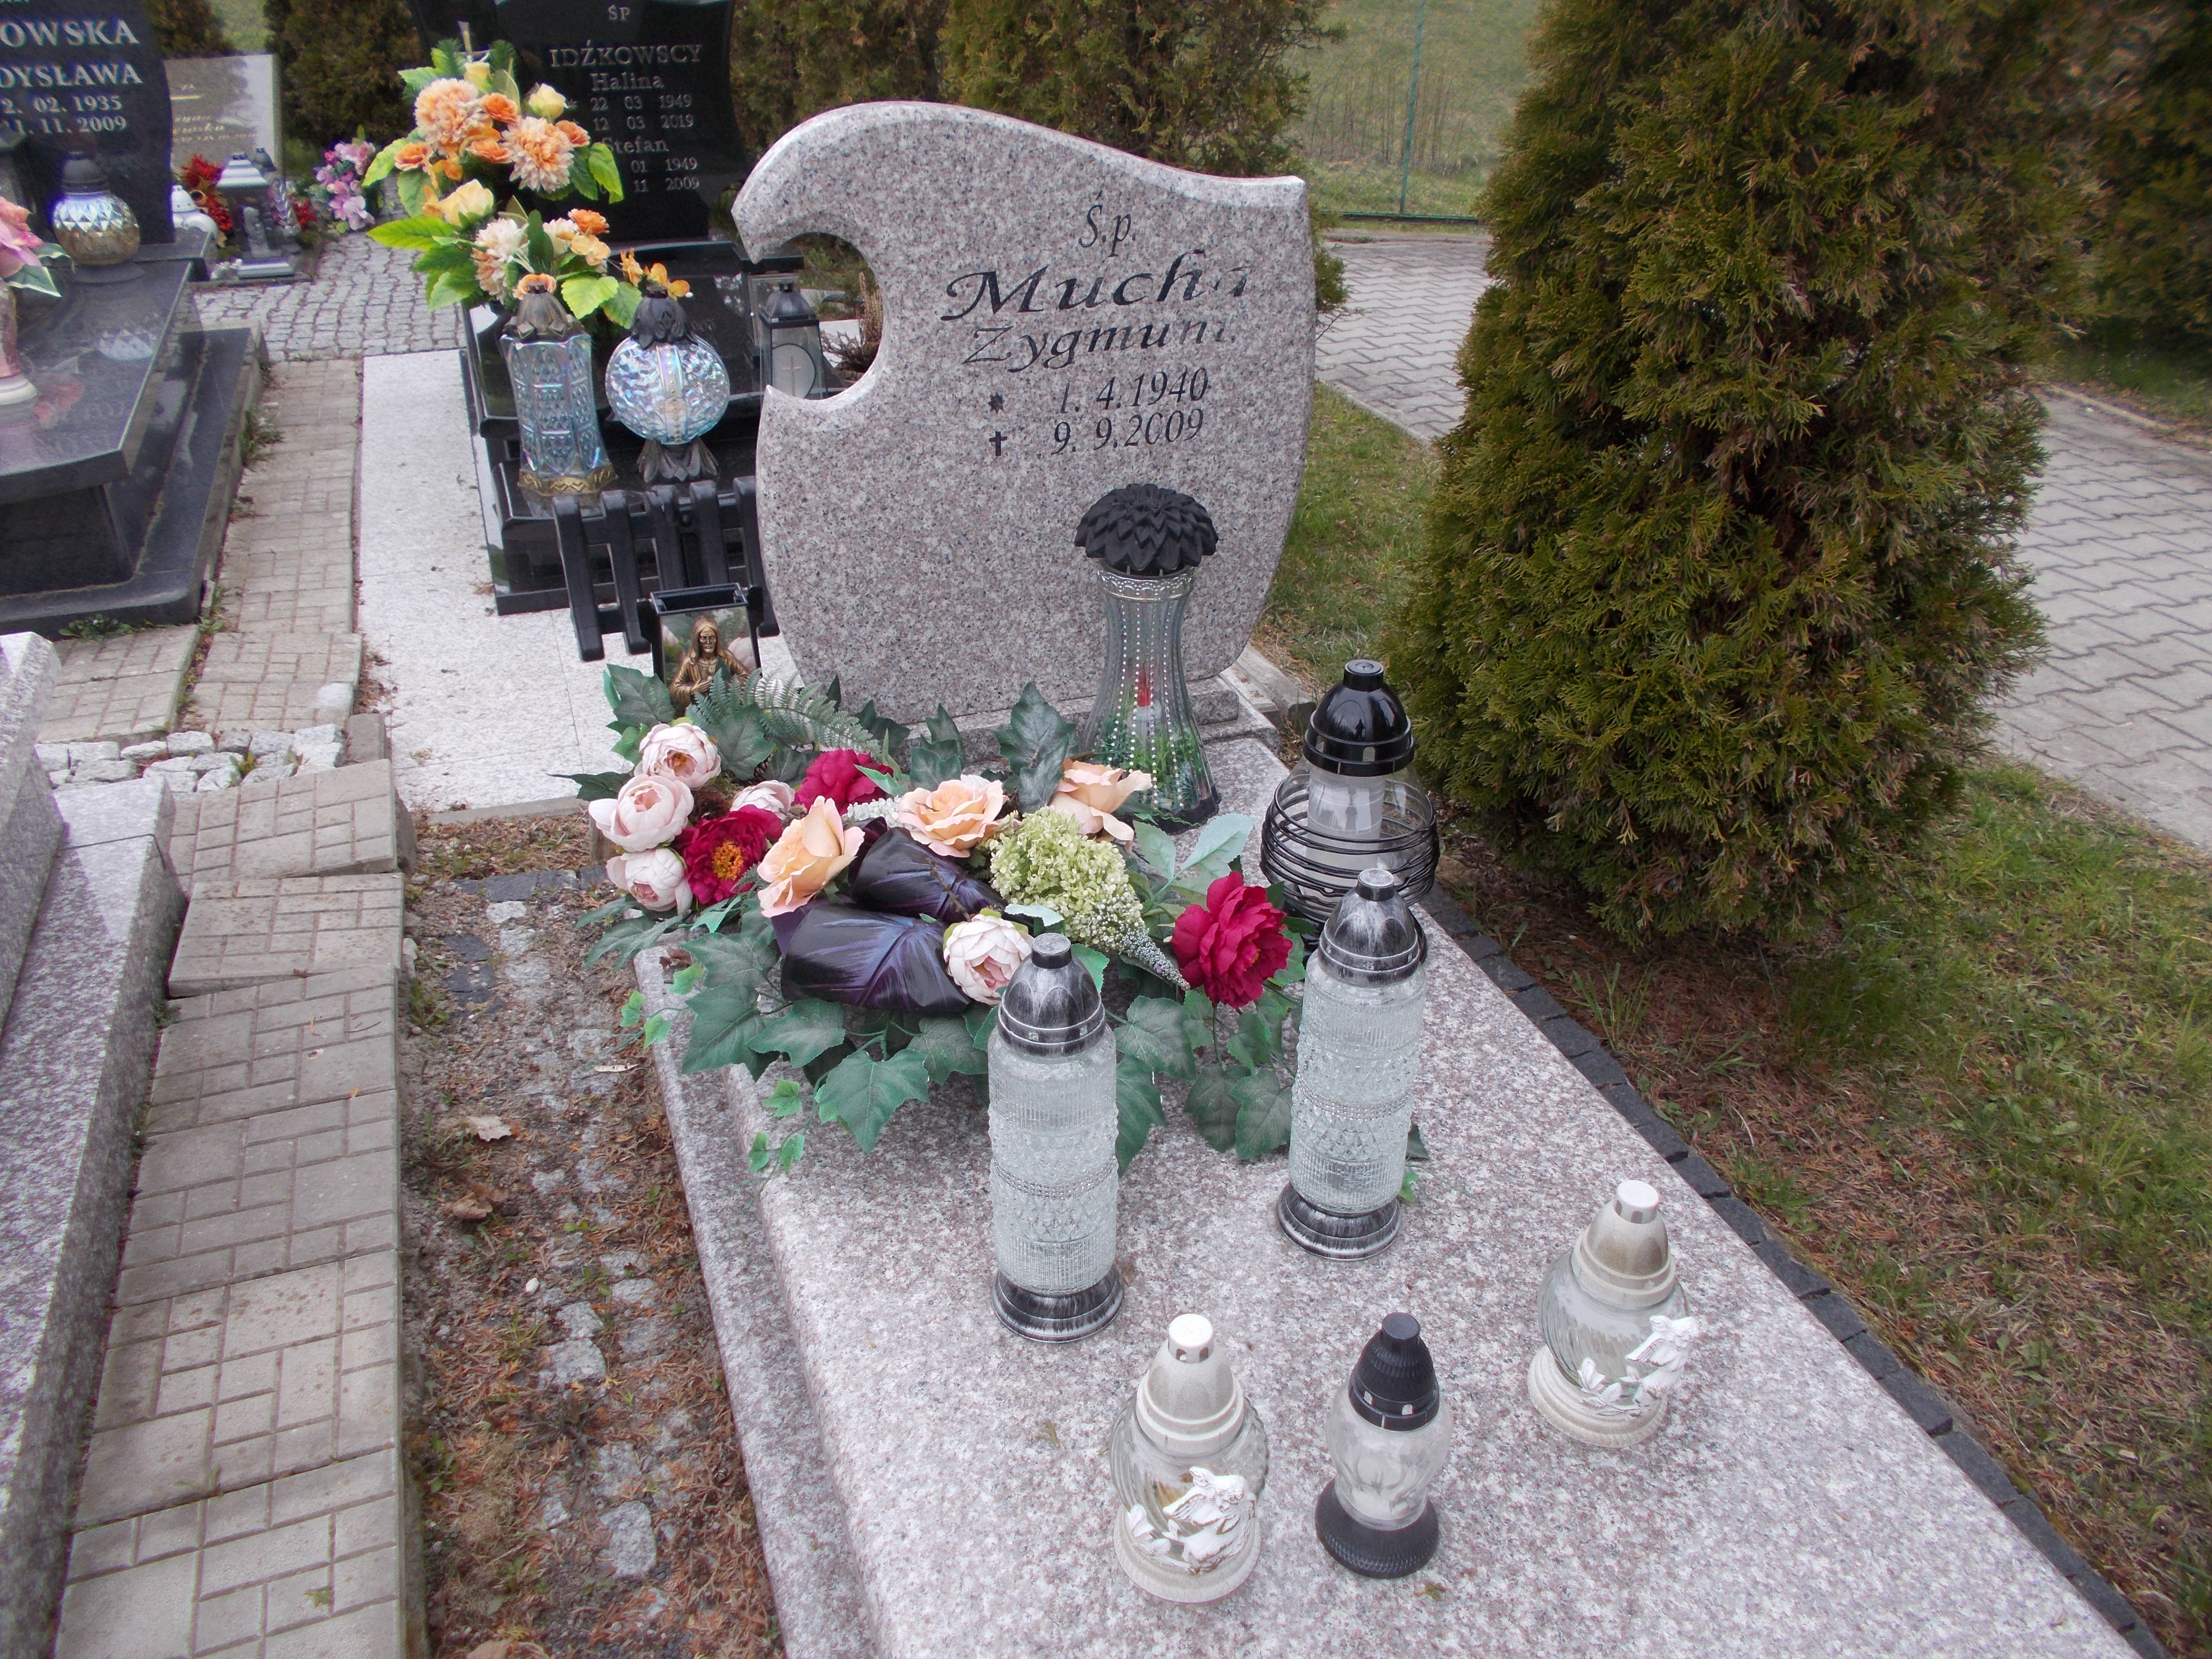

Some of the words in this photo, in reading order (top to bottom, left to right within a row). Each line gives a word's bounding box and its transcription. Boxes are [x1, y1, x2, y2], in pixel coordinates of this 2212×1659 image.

[550, 39, 702, 67] IDŹKOWSCY
[590, 72, 664, 91] Halina
[33, 96, 67, 113] 02.
[72, 95, 122, 111] 1935
[590, 97, 608, 111] 22
[624, 96, 643, 109] 03
[659, 94, 693, 108] 1949
[40, 118, 72, 133] 11.
[76, 116, 127, 133] 2009
[592, 118, 609, 131] 12
[626, 116, 645, 130] 03
[661, 114, 694, 128] 2019
[601, 135, 669, 154] Stefan
[631, 159, 648, 173] 01
[665, 157, 698, 171] 1949
[634, 179, 648, 192] 11
[665, 177, 699, 191] 2009
